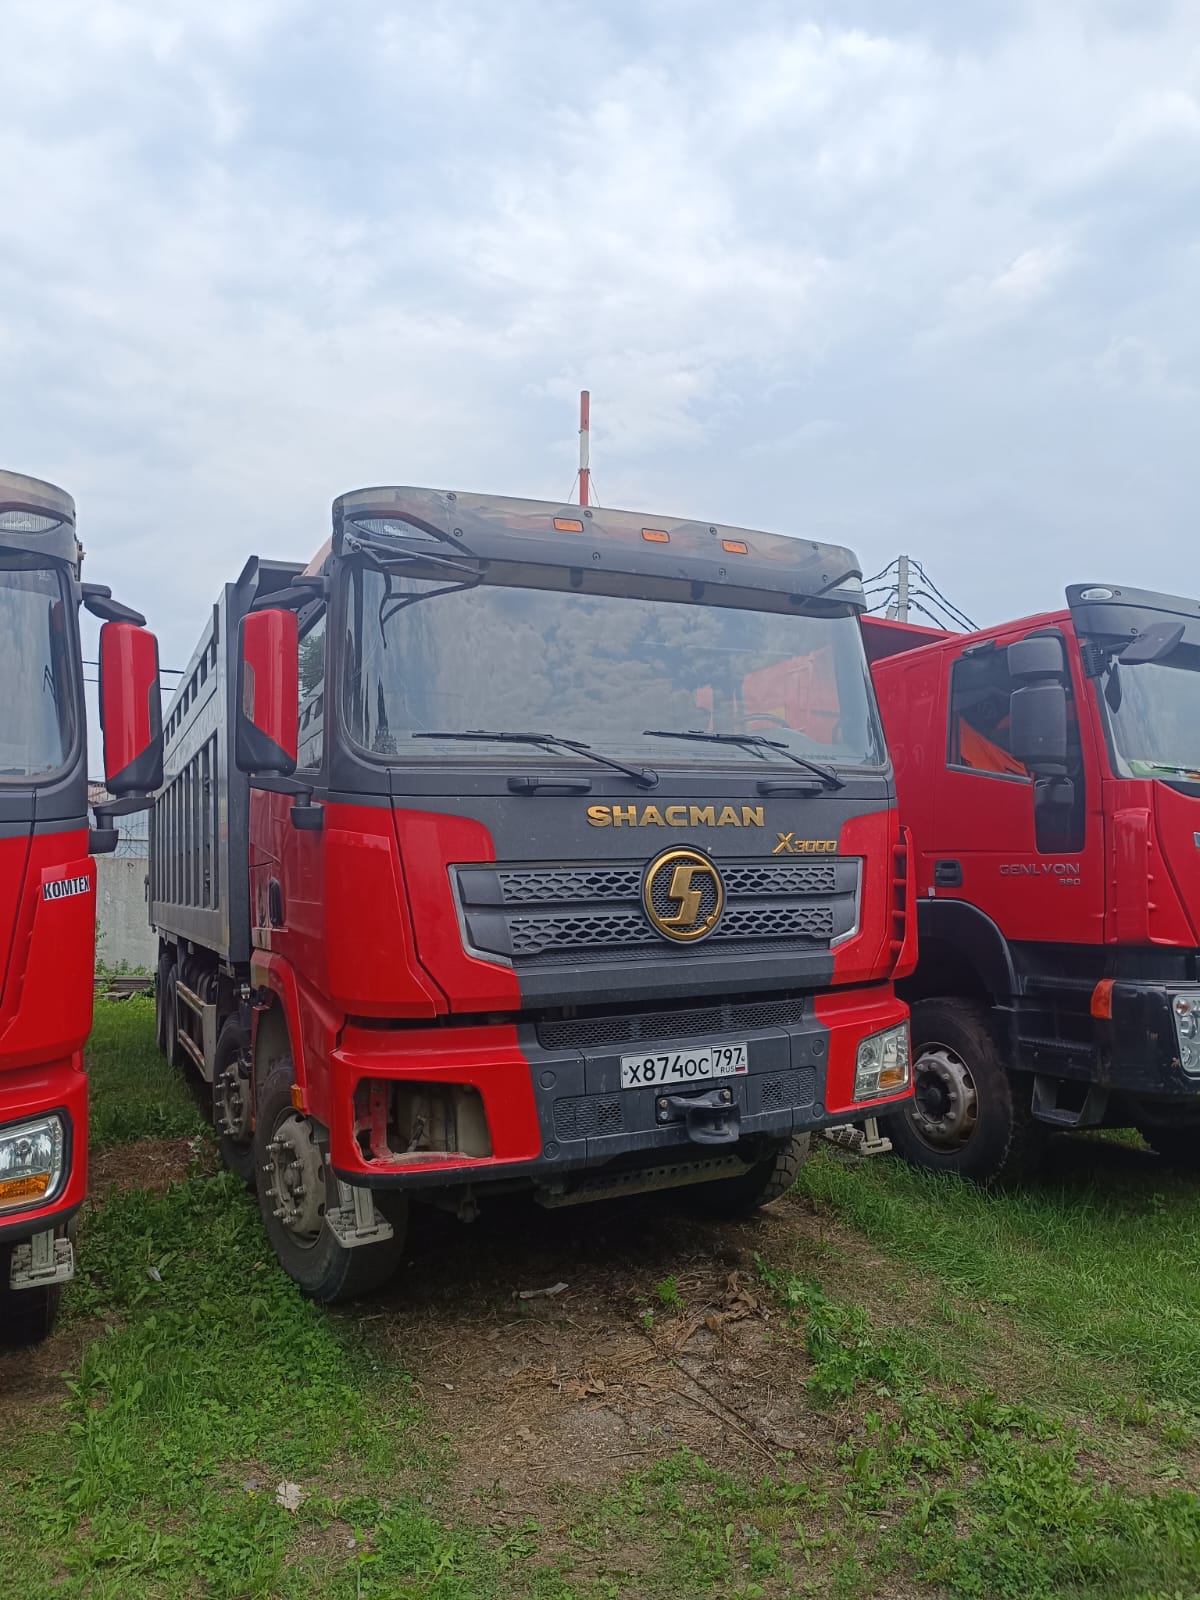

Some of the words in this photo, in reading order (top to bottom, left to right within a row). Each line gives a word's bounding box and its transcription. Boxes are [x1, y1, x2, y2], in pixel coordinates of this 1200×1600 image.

[586, 805, 765, 827] SHACMAN
[772, 832, 838, 854] X3000
[713, 1047, 743, 1067] 797
[720, 1065, 735, 1073] RUS
